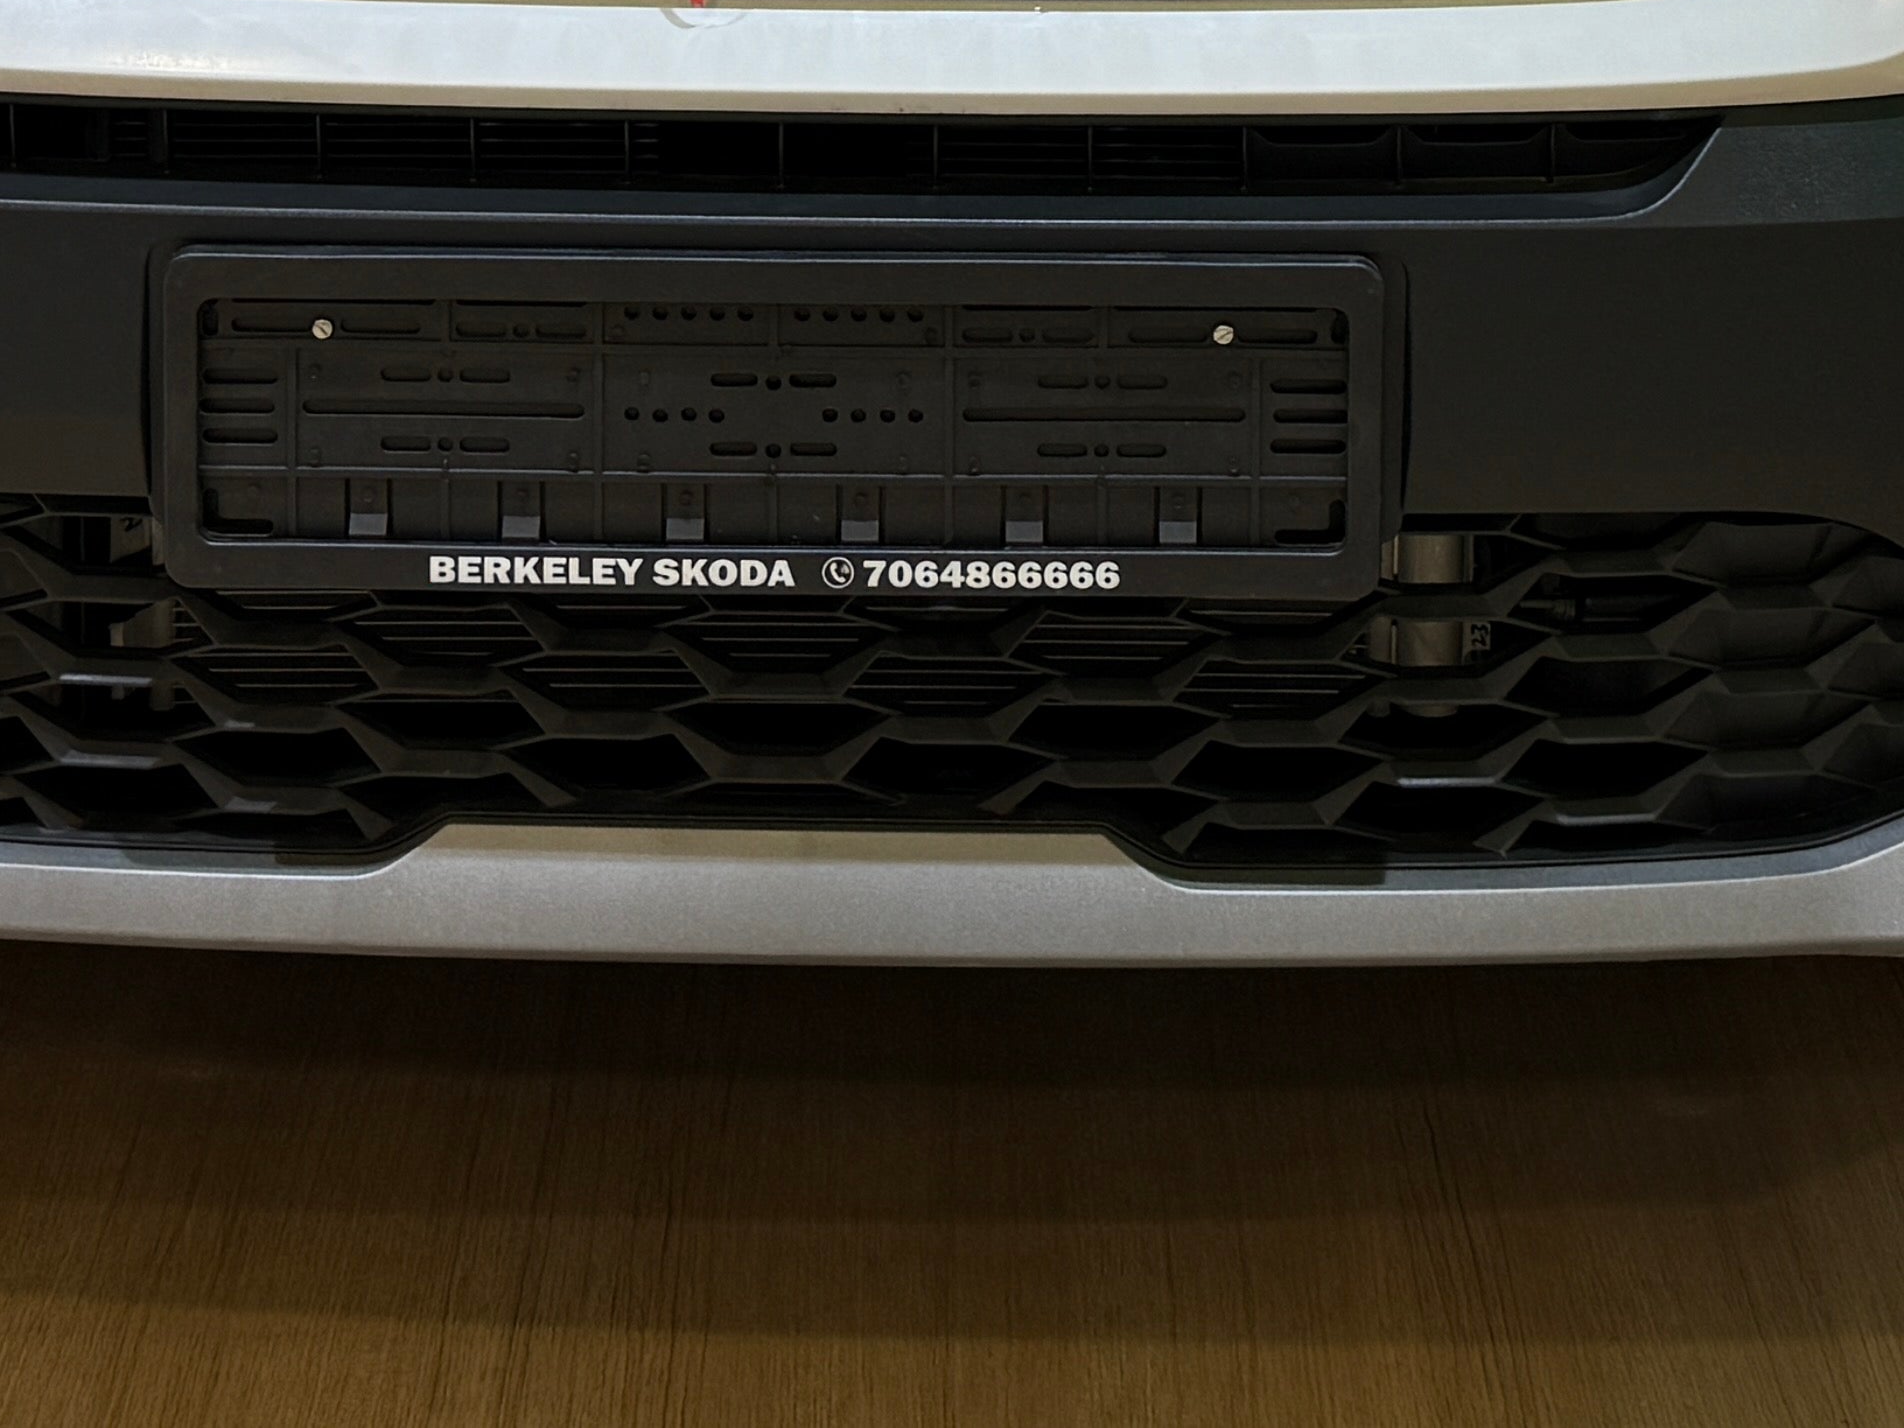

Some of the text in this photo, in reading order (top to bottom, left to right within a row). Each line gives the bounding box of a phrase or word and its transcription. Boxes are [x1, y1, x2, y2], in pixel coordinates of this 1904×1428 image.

[429, 555, 1121, 591] BERKELEY SKODA 7064866666
